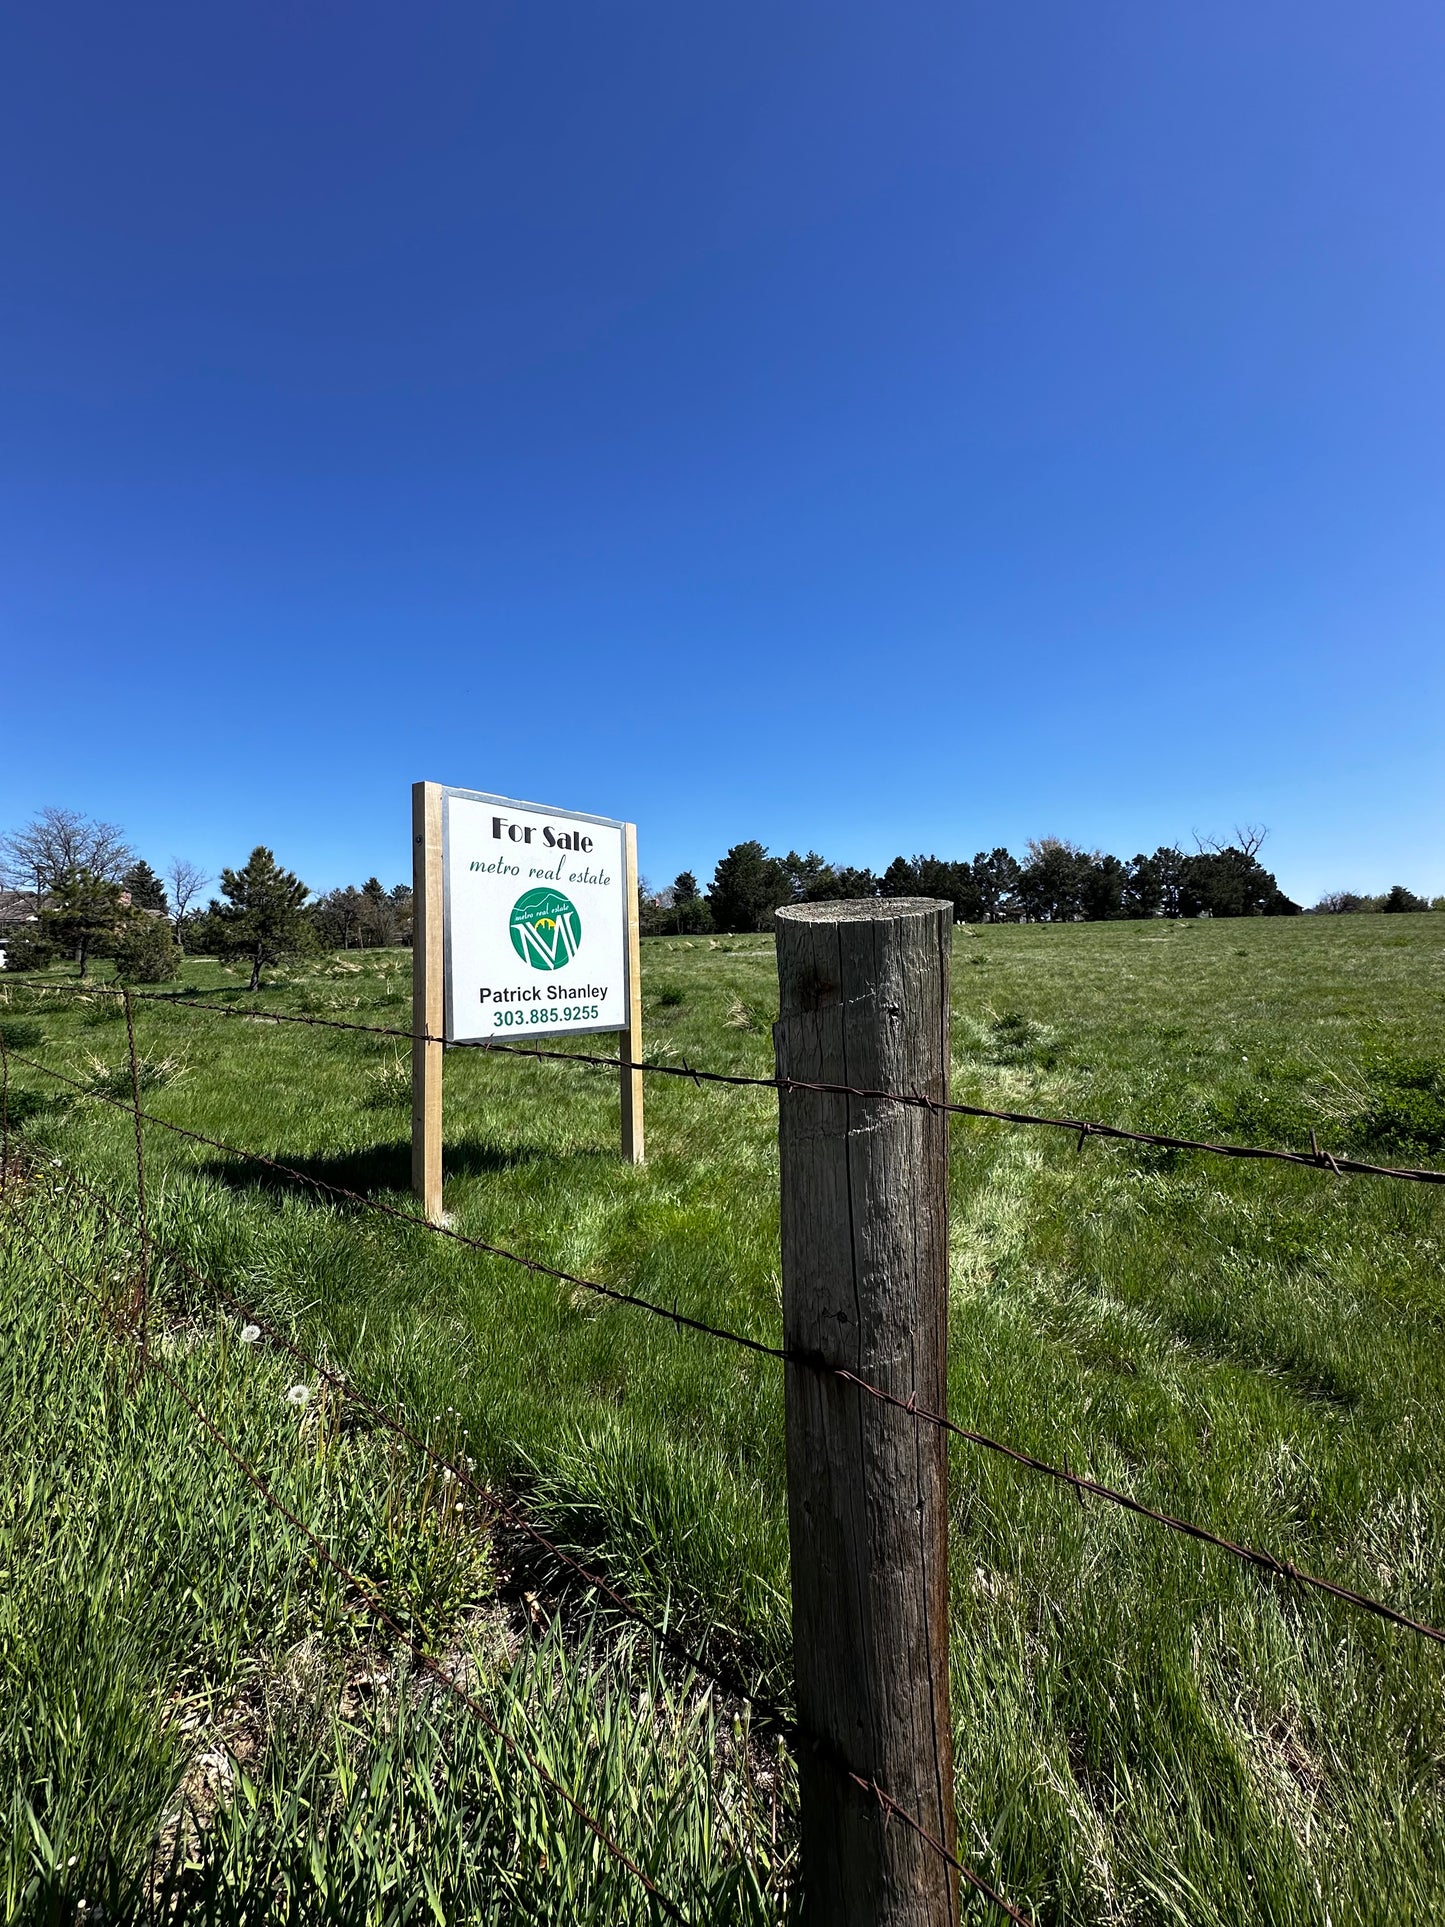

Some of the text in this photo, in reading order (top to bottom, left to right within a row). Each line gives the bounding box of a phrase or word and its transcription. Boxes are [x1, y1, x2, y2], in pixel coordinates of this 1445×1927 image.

[492, 817, 593, 853] For Sale
[470, 855, 611, 886] metro real estate
[480, 984, 608, 1003] Patrick Shanley
[493, 1005, 599, 1027] 303.885.9255
